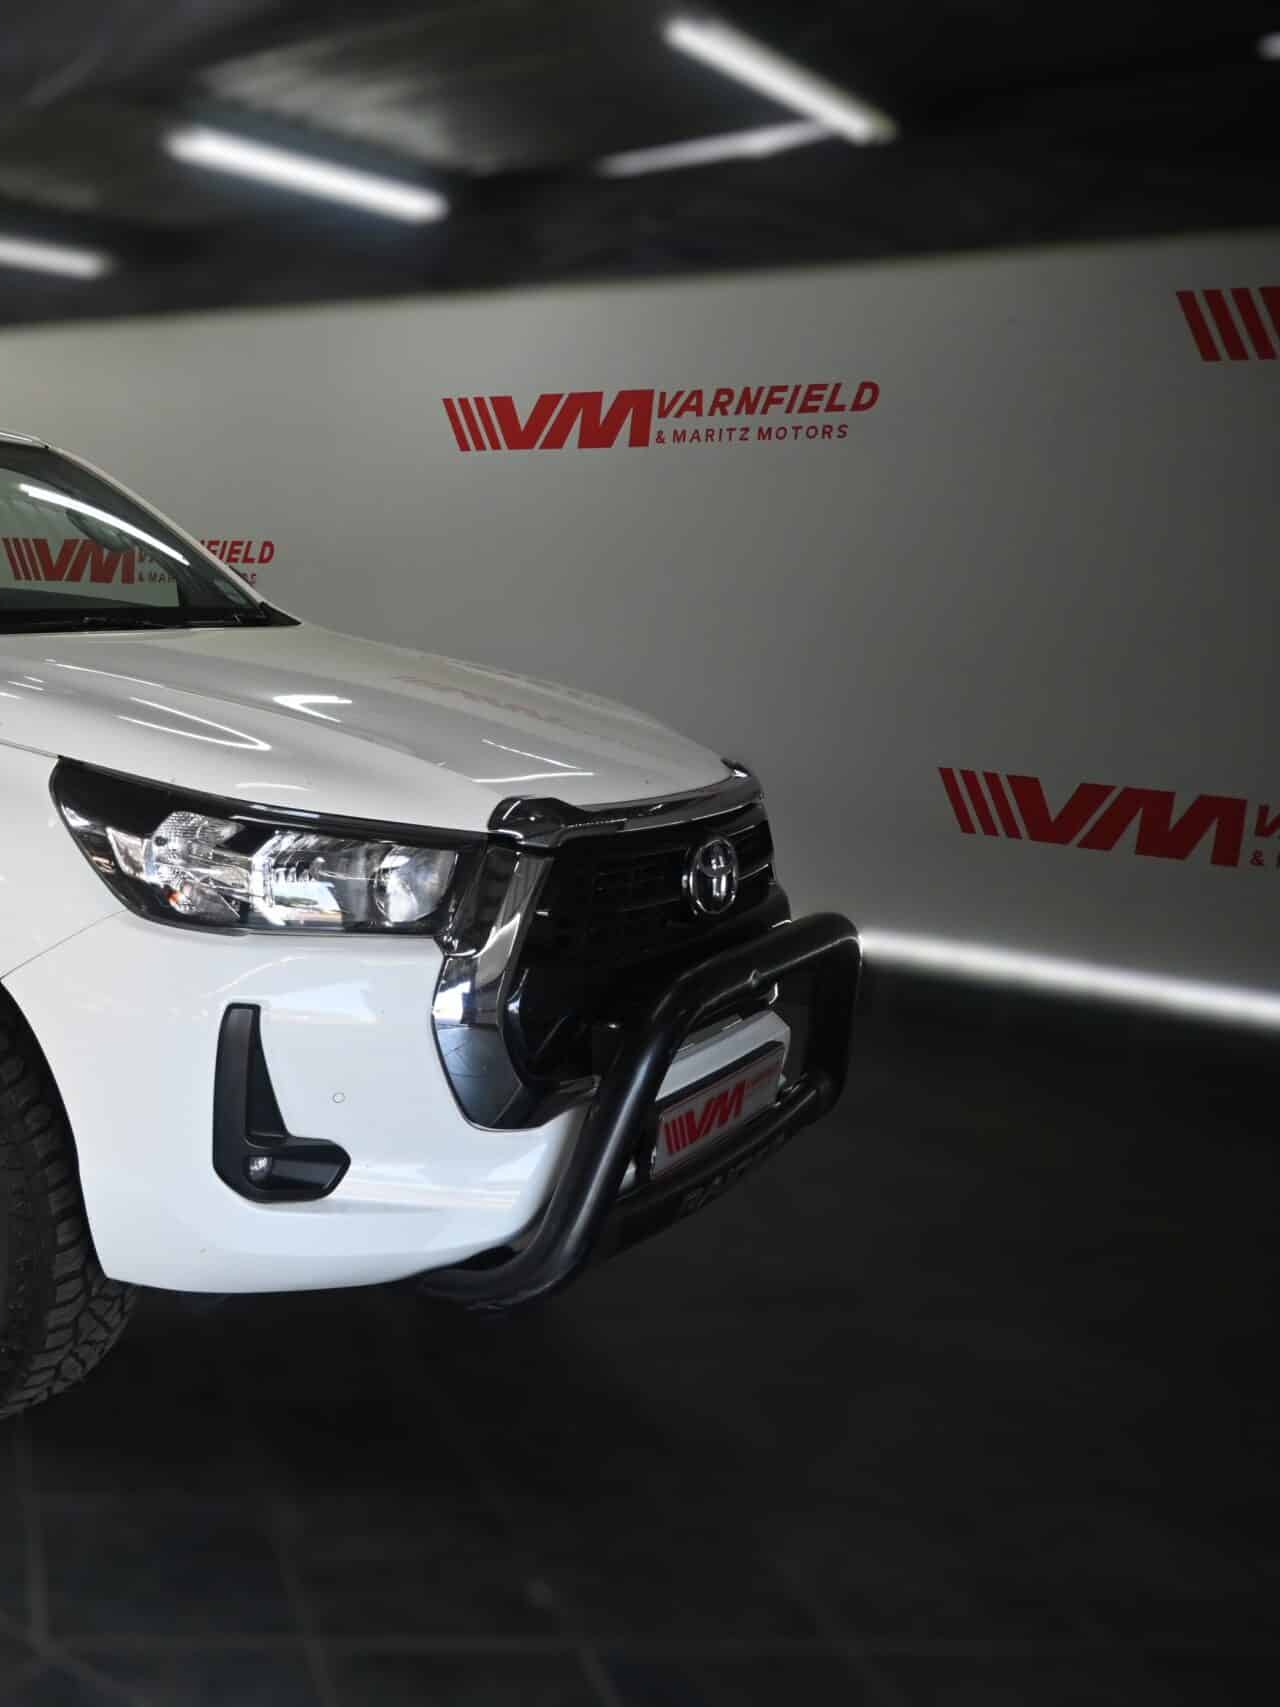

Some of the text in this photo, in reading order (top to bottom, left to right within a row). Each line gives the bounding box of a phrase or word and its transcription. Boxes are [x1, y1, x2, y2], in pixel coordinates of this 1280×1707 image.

[490, 388, 655, 451] VM
[656, 379, 881, 419] VARNFIELD
[655, 423, 849, 445] & MARITZ MOTORS
[31, 538, 135, 584] VM
[1005, 773, 1248, 868] VM
